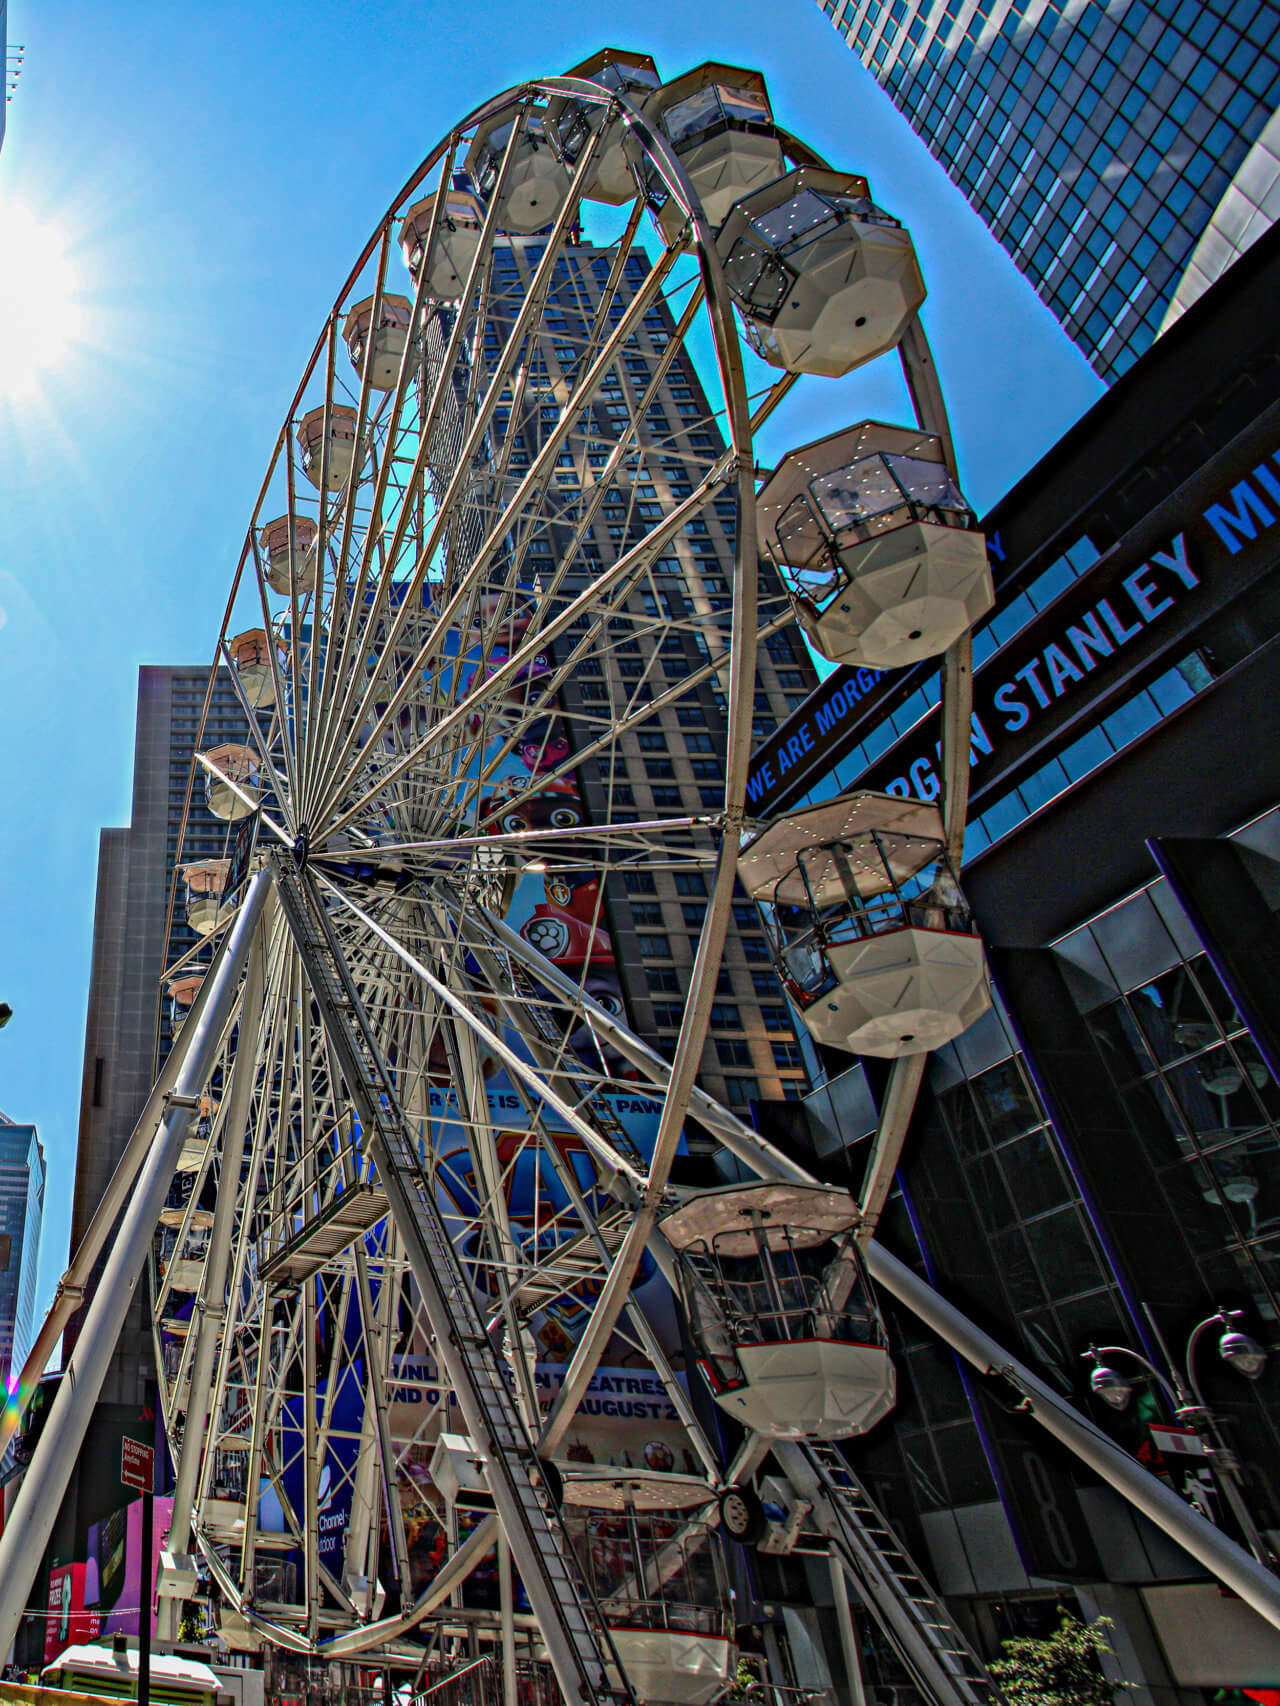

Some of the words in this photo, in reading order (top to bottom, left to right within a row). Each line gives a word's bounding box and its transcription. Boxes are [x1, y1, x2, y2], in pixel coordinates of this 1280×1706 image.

[993, 531, 1201, 733] STANLEY
[745, 761, 777, 804] WE
[776, 722, 816, 777] ARE
[554, 1371, 669, 1396] TEATRES
[319, 1508, 346, 1532] Channel
